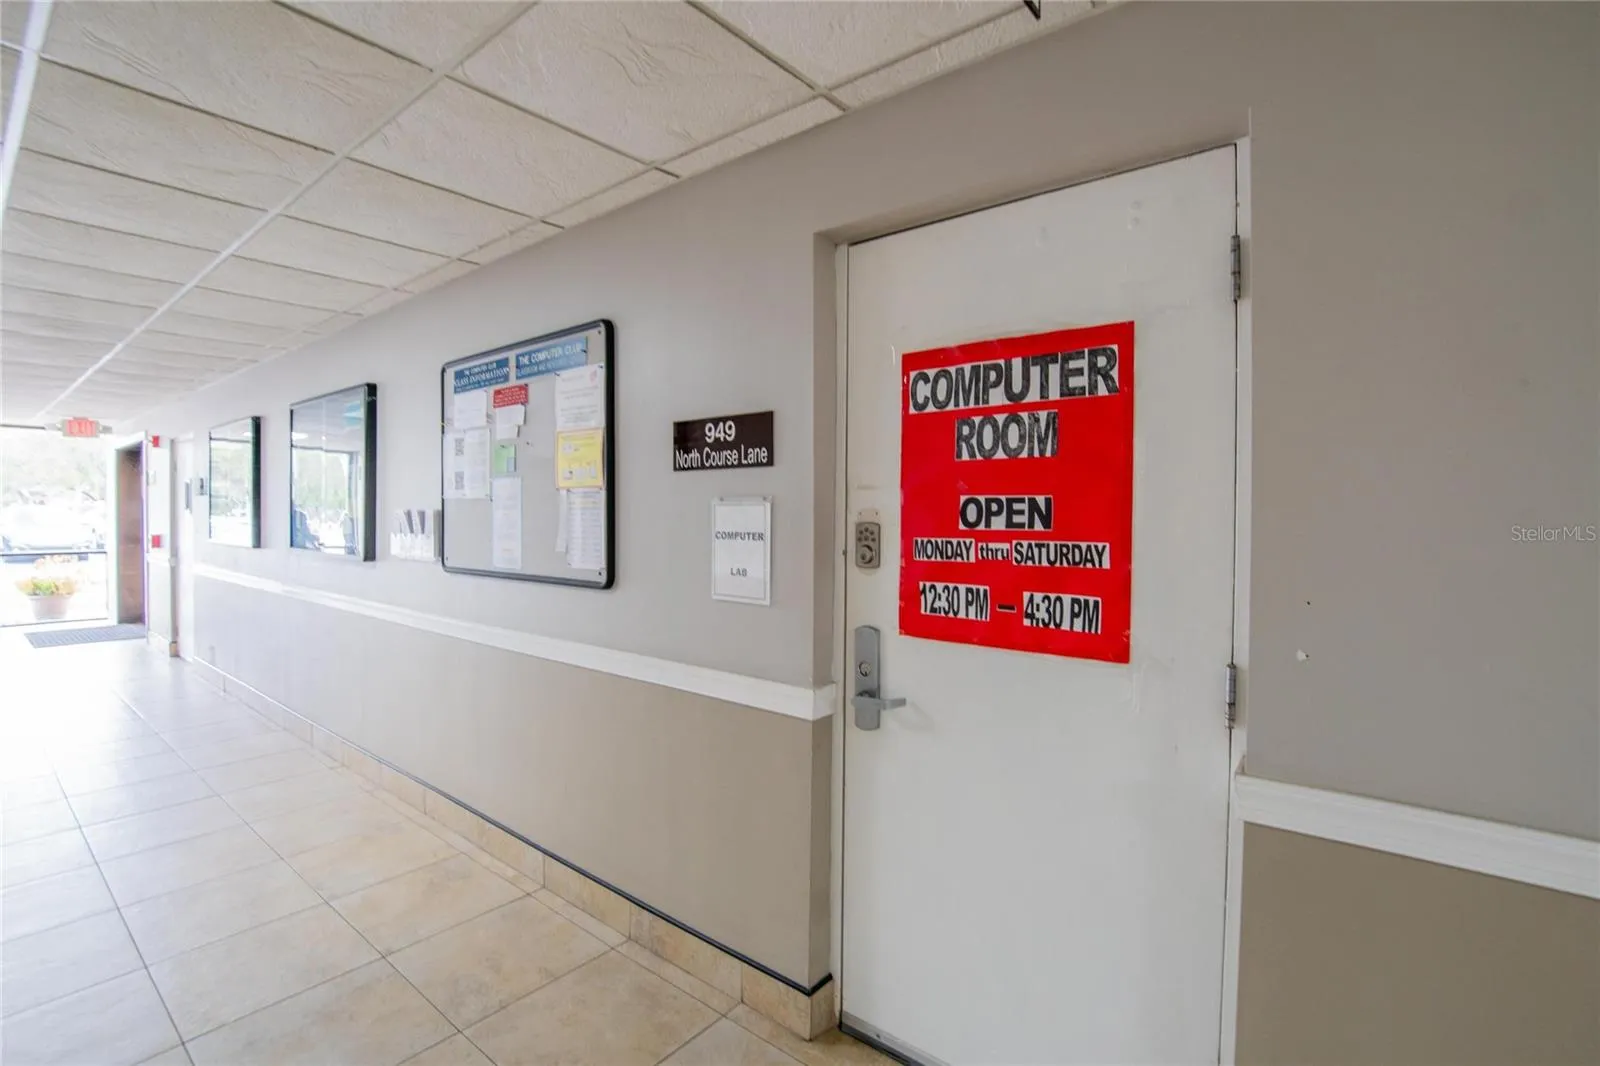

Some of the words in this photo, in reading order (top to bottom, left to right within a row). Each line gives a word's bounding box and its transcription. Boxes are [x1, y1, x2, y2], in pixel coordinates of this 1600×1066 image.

[531, 345, 562, 363] COMPUTER
[911, 346, 1120, 412] COMPUTER
[704, 420, 736, 443] 949
[956, 411, 1058, 459] ROOM
[675, 448, 700, 469] North
[703, 447, 738, 467] Course
[741, 444, 768, 465] Lane
[959, 496, 1053, 530] OPEN
[715, 531, 764, 541] COMPUTER
[914, 538, 974, 561] MONDAY
[979, 544, 1009, 560] thru
[1013, 541, 1107, 569] SATURDAY
[730, 567, 747, 577] LAB
[920, 583, 960, 617] 12:30
[965, 586, 989, 620] PM
[1024, 593, 1064, 629] 4:30
[1070, 597, 1100, 634] PM
